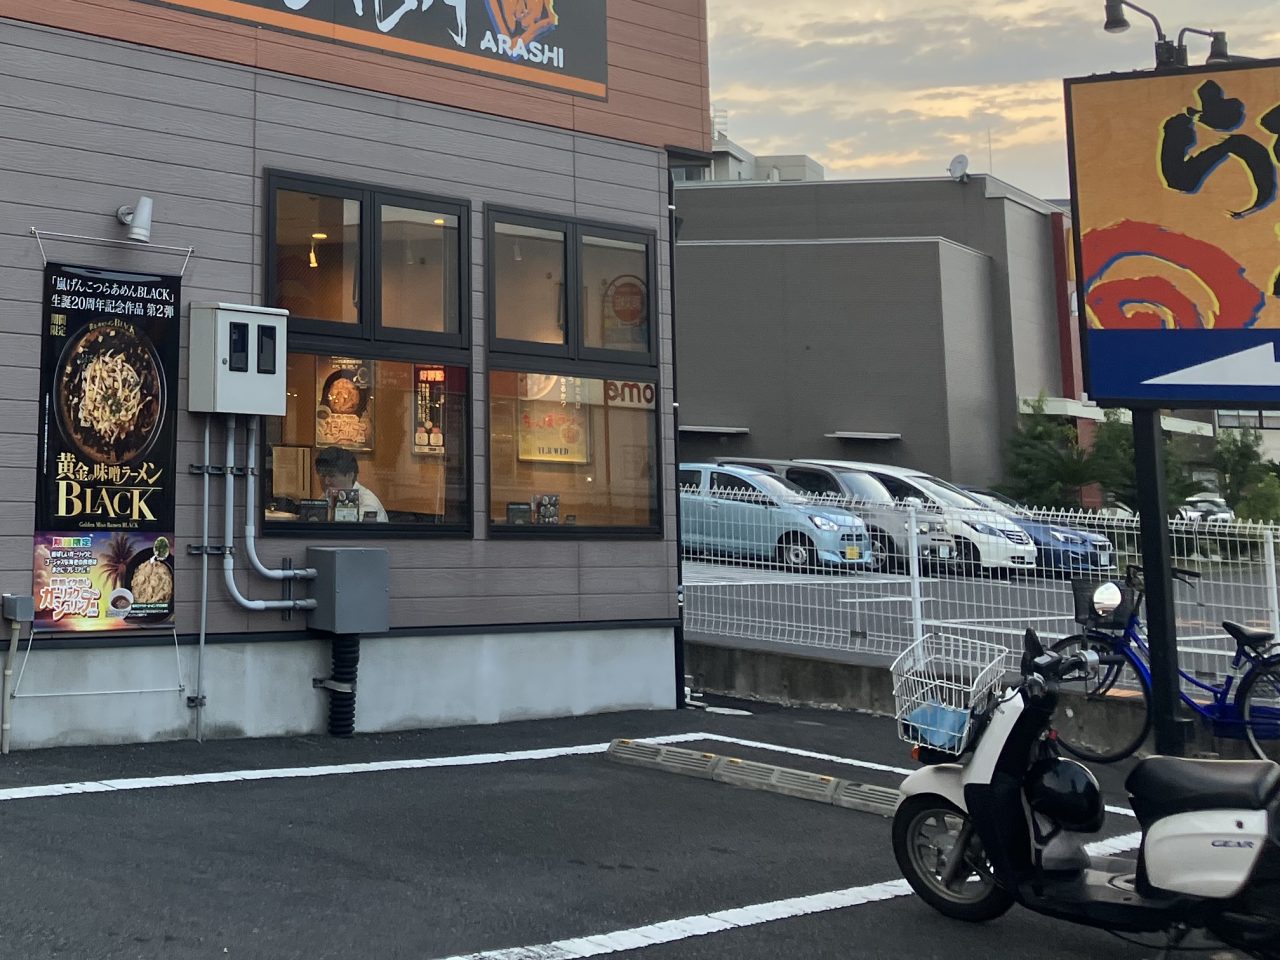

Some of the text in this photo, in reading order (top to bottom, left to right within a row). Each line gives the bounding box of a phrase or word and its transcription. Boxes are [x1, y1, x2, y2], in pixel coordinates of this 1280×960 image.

[480, 30, 564, 68] ARASHI
[51, 294, 175, 318] 生誕20周年記念作品 第2弾
[56, 452, 163, 485] 黄金の味噌ラーメン
[54, 480, 158, 521] BLACK
